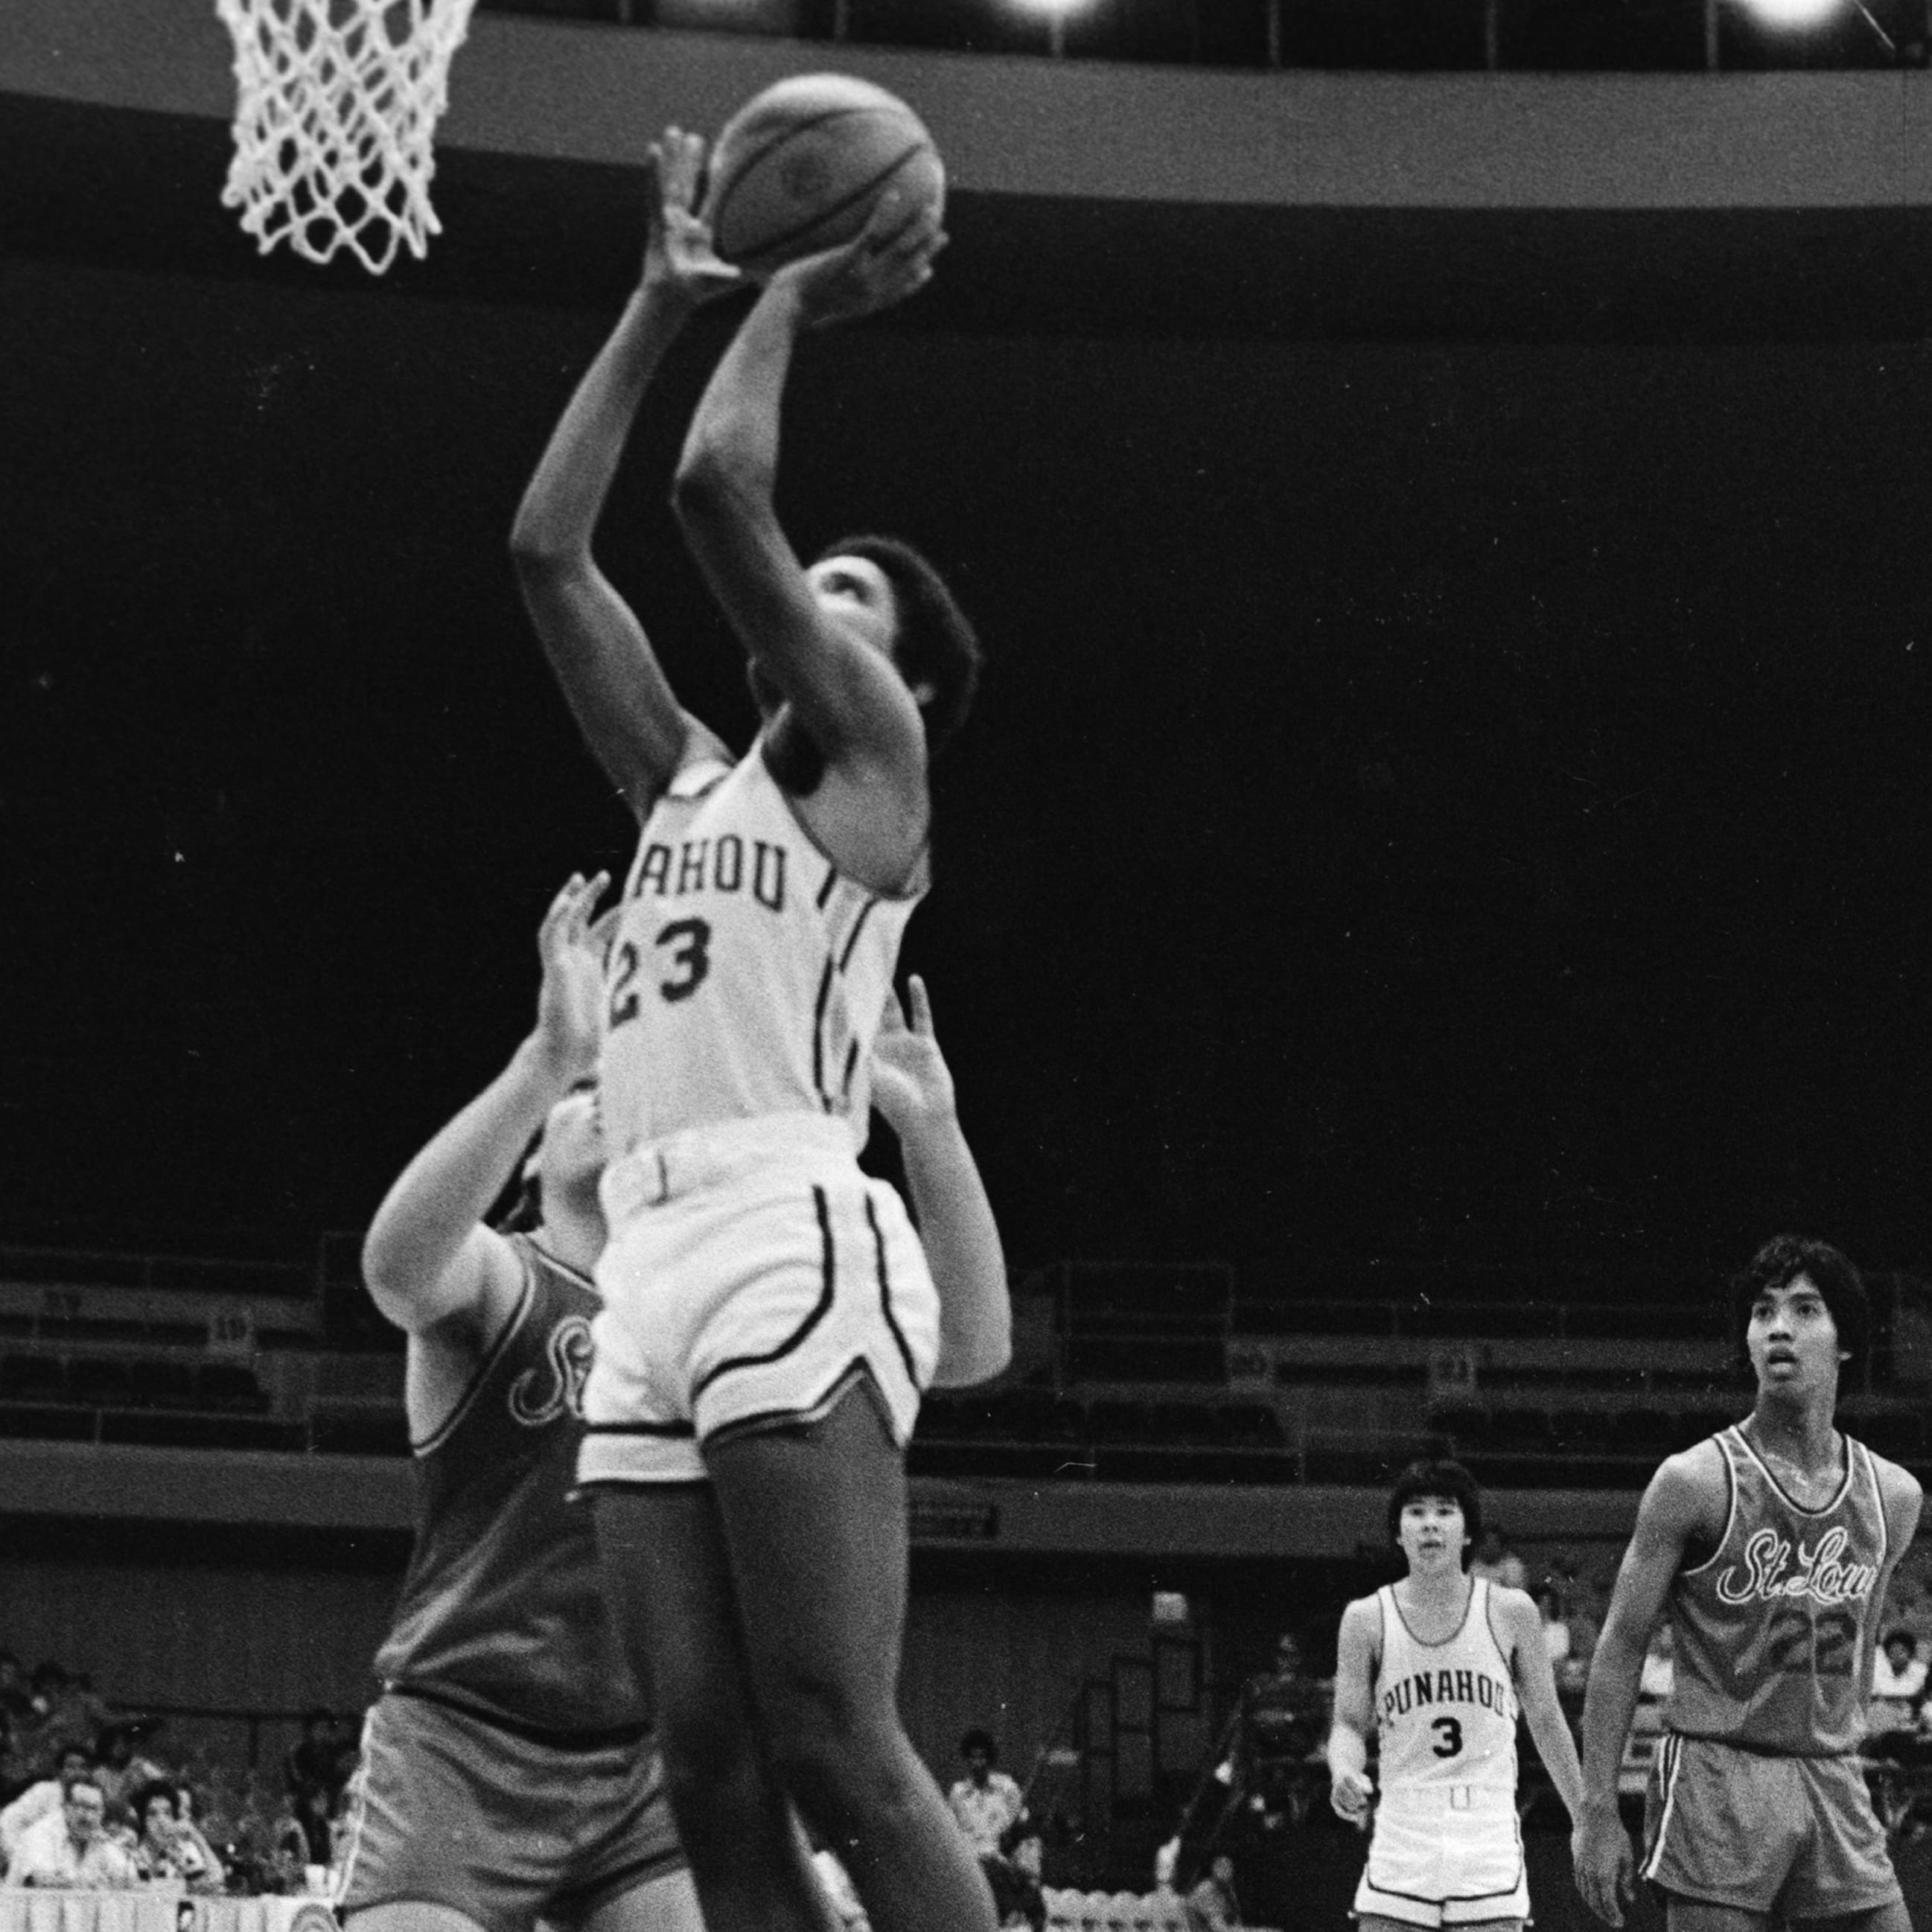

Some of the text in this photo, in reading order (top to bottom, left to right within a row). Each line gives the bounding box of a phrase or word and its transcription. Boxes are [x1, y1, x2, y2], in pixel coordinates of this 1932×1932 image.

[634, 833, 787, 913] AHOU
[608, 917, 712, 1032] 23
[1769, 1609, 1858, 1677] 22
[1383, 1668, 1505, 1729] PUNAHOU
[1430, 1715, 1464, 1759] 3
